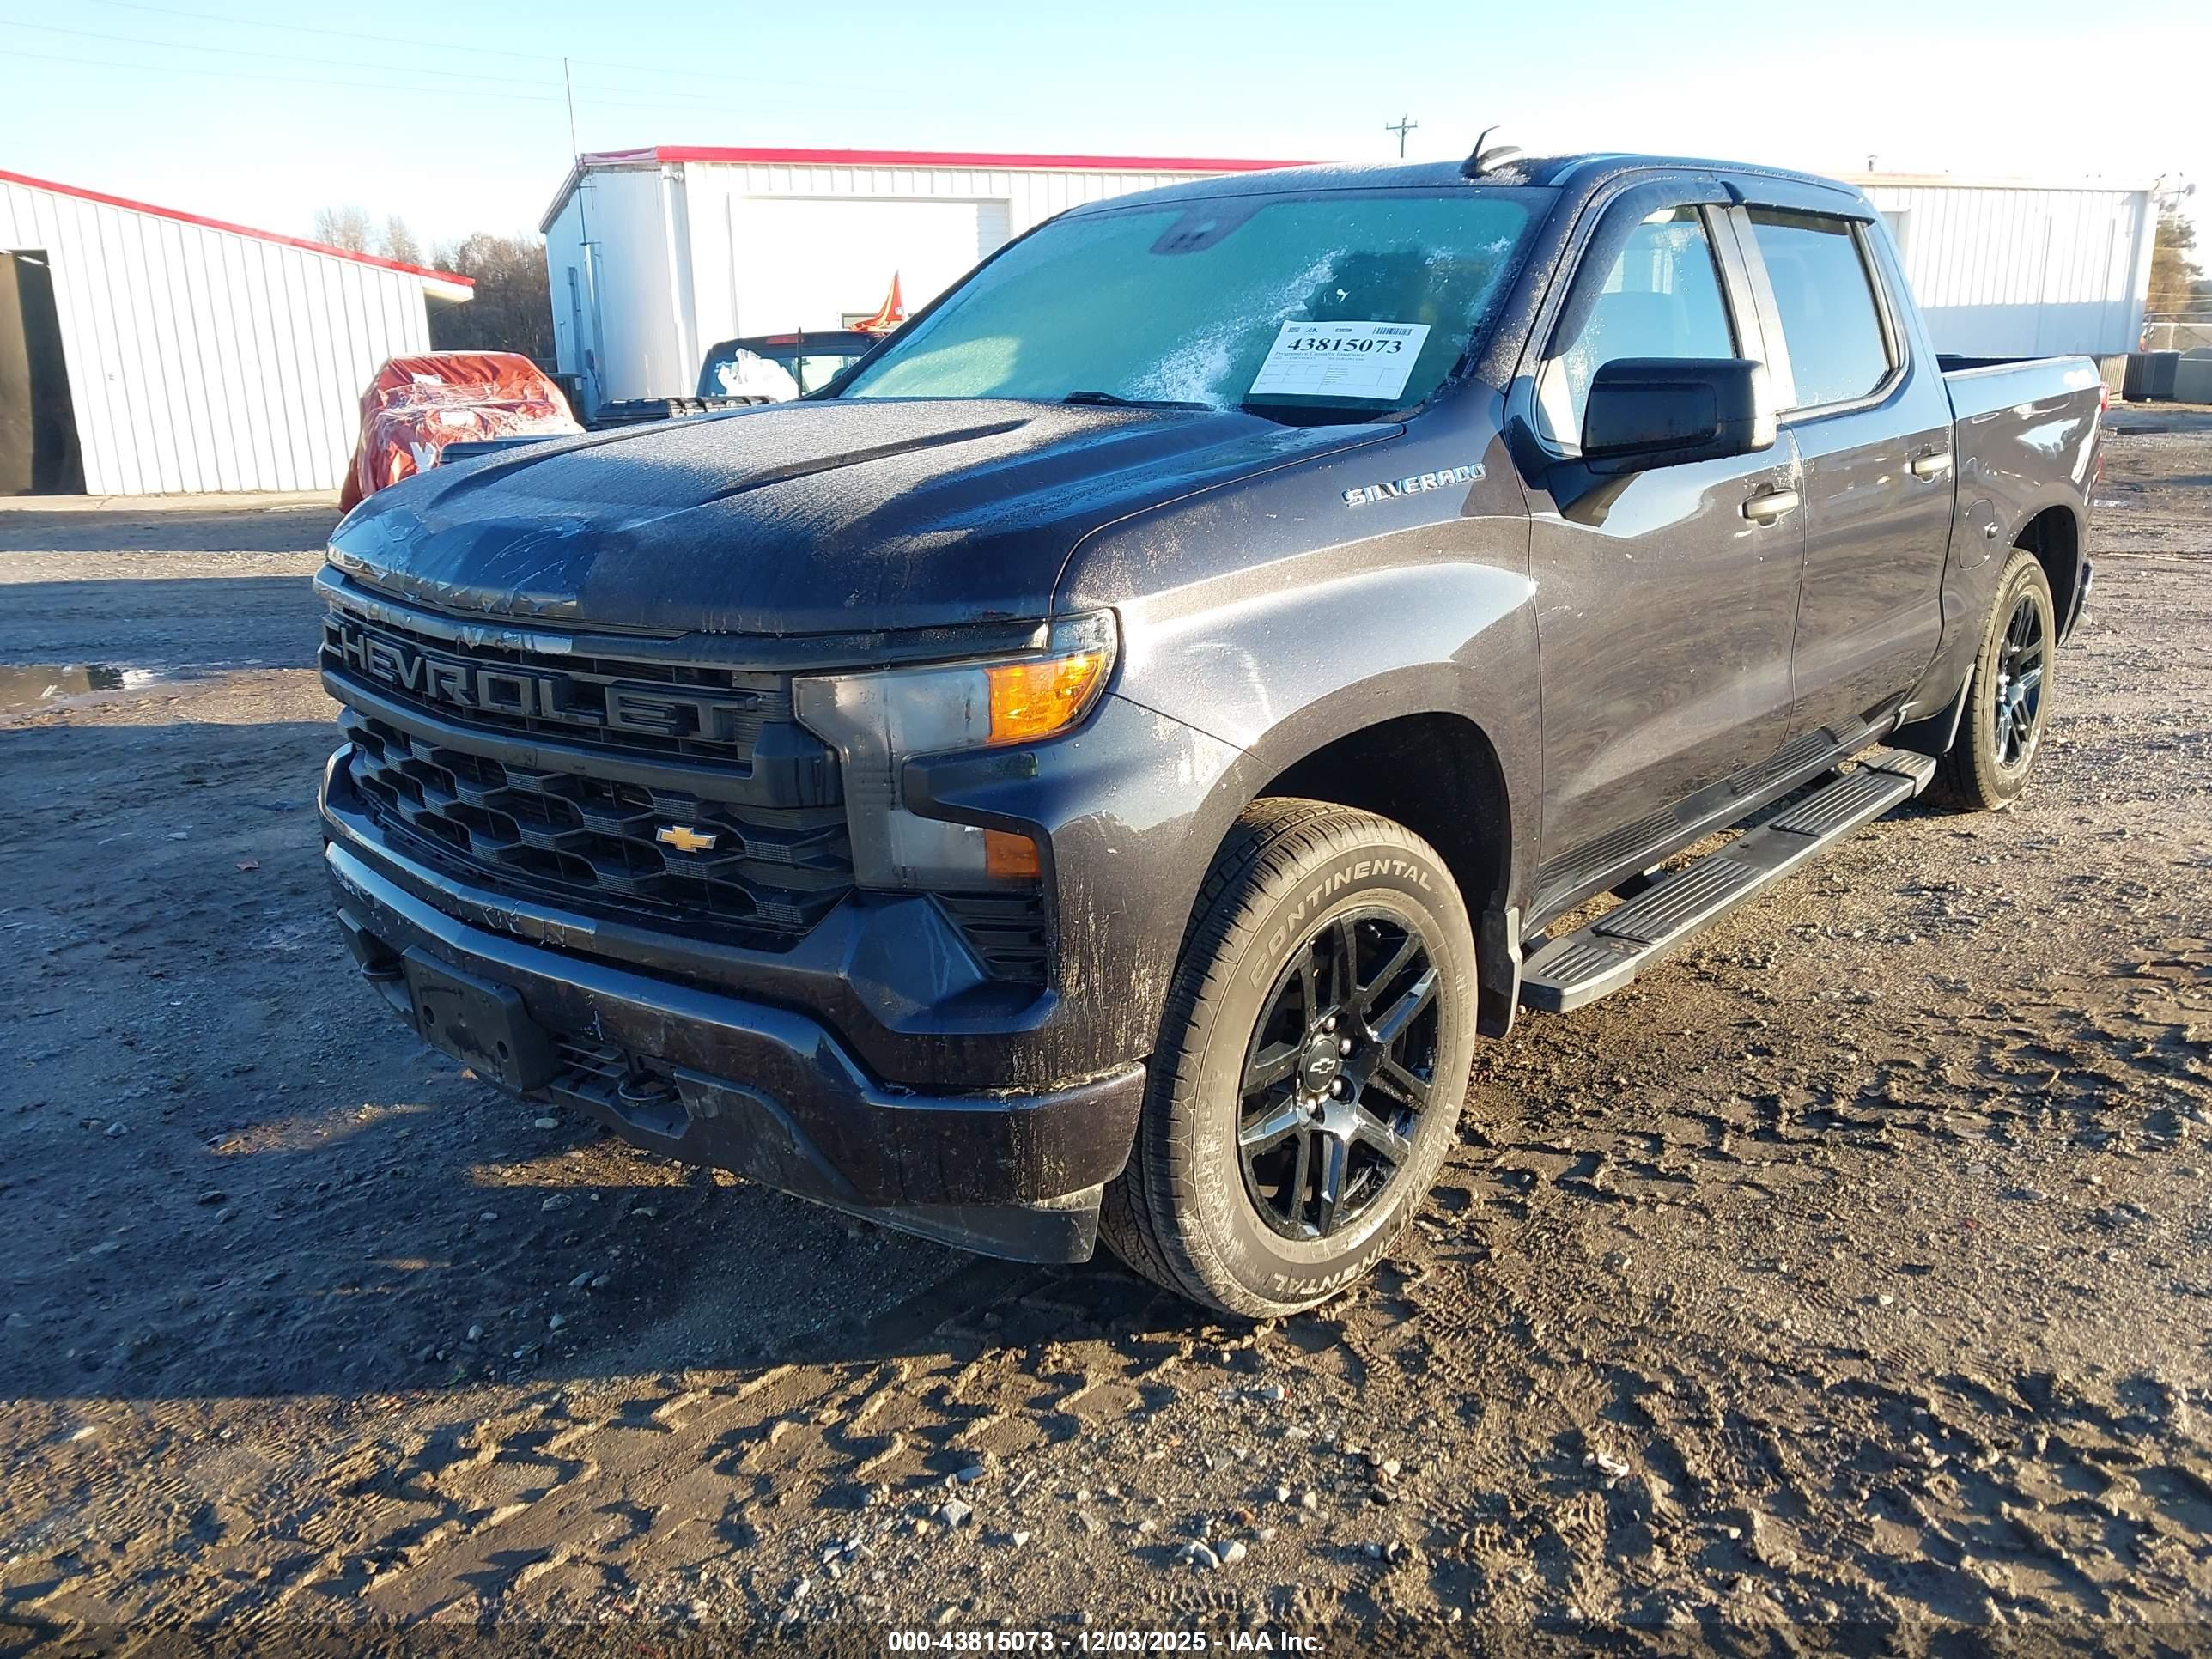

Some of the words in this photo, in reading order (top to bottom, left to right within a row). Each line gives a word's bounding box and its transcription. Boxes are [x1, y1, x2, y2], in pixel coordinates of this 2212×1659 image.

[1287, 337, 1403, 354] 43815073
[1341, 462, 1487, 508] SILVERADO
[322, 613, 763, 742] CHEVROLET
[1249, 858, 1435, 988] CONTINENTAL
